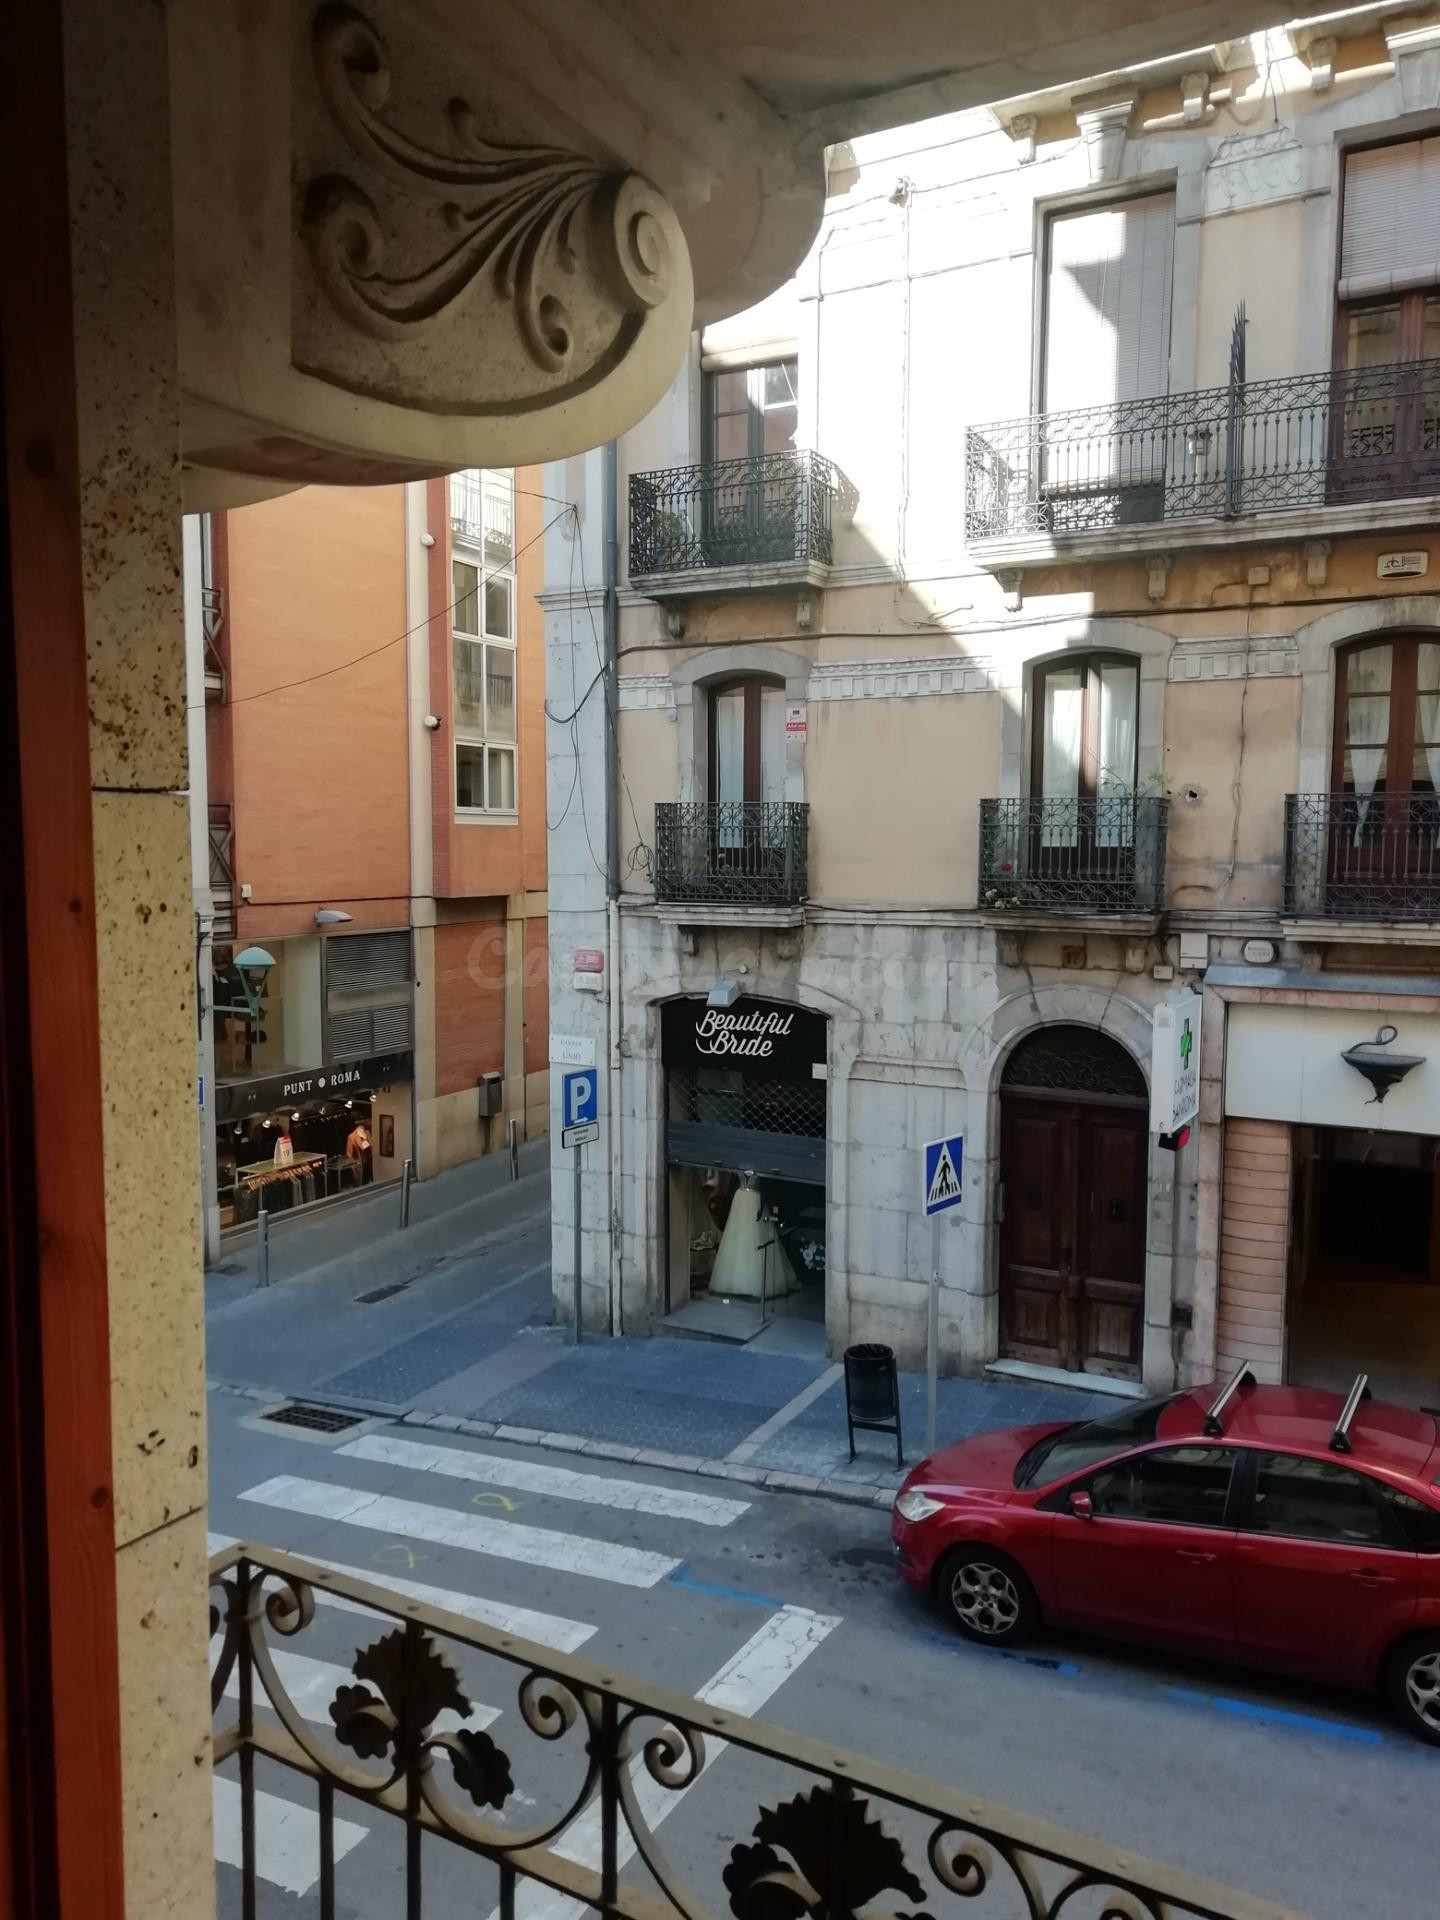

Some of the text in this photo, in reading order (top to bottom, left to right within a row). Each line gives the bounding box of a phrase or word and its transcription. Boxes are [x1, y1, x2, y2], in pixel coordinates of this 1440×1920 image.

[695, 1009, 795, 1037] Beautiful
[695, 1029, 774, 1057] Bride
[283, 1070, 361, 1097] PUNT ROMA
[570, 1076, 592, 1121] P
